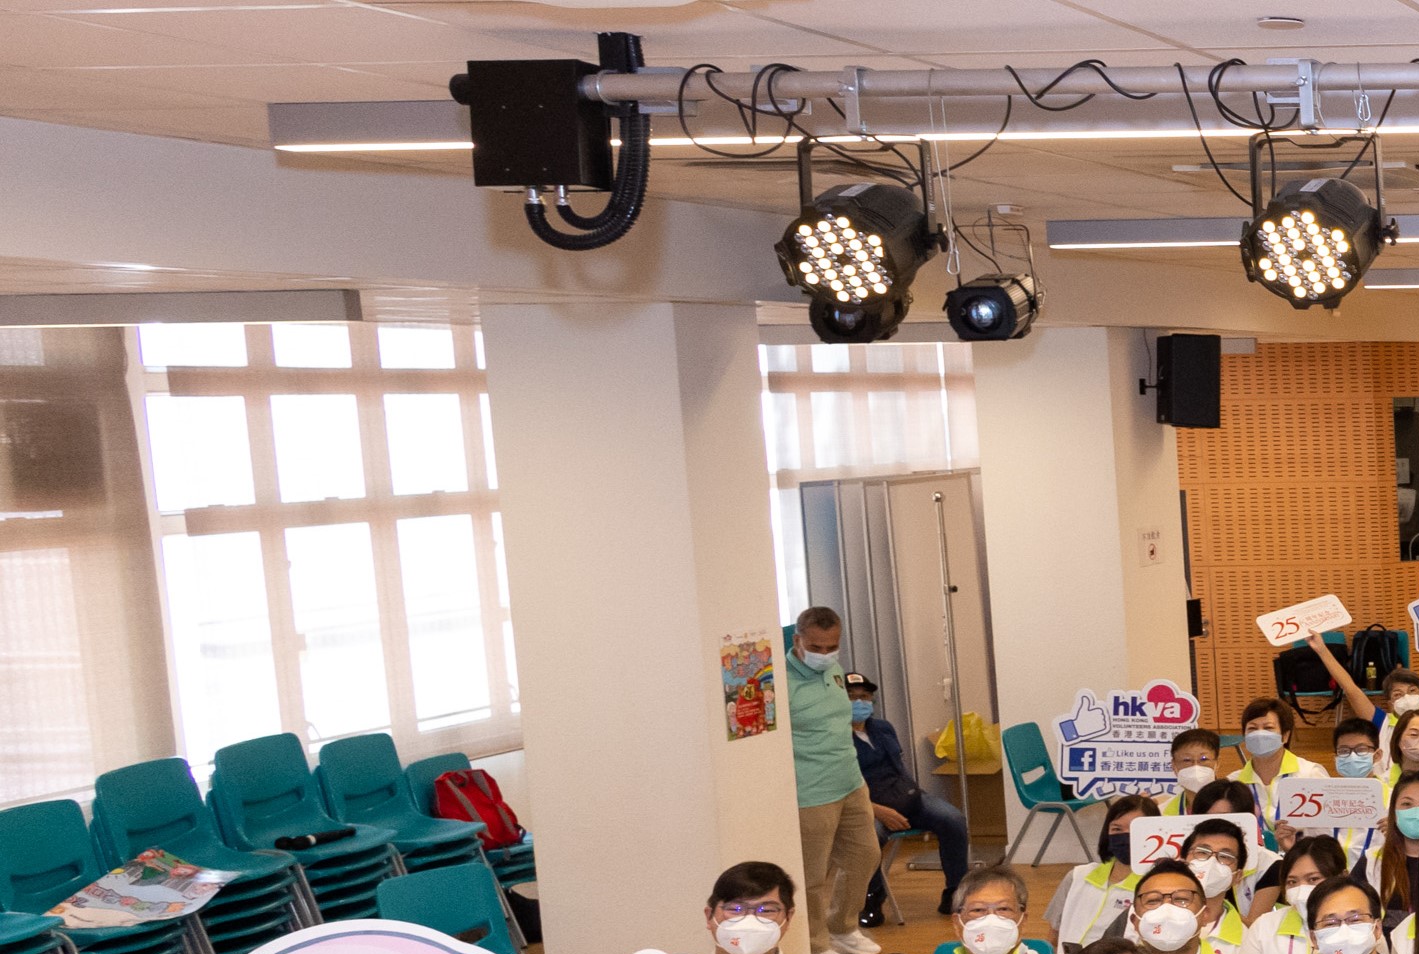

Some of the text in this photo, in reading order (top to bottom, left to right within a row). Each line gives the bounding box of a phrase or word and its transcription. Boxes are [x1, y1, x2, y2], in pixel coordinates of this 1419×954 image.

[1272, 616, 1300, 640] 25
[1113, 696, 1180, 718] hkva
[1116, 750, 1134, 758] Like
[1287, 793, 1324, 817] 25
